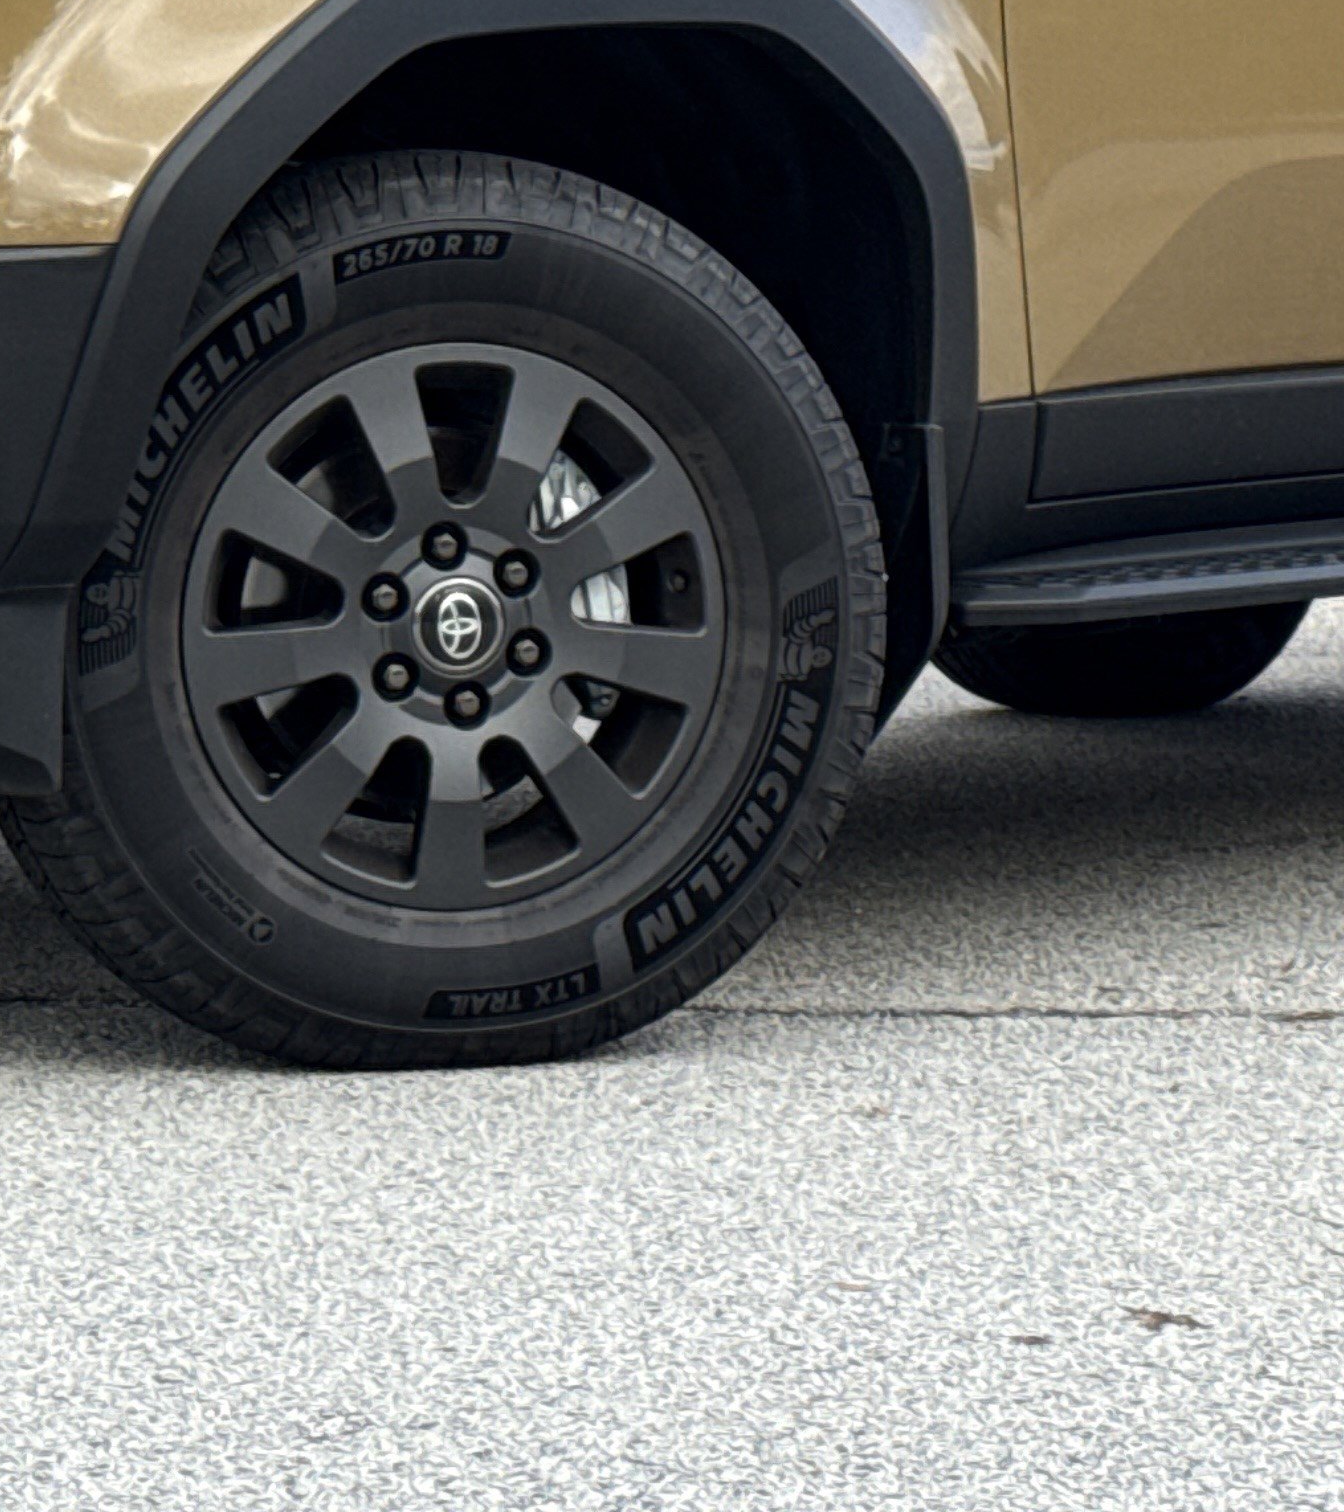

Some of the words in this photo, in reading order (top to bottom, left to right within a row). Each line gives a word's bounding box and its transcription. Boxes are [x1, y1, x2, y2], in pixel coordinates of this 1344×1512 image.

[341, 236, 437, 278] 265/70
[443, 234, 463, 257] R
[472, 234, 500, 257] 18
[106, 293, 293, 564] MICHELIN
[636, 688, 821, 955] MICHELIN
[448, 989, 523, 1016] TRAIL
[535, 972, 586, 1009] LTX
